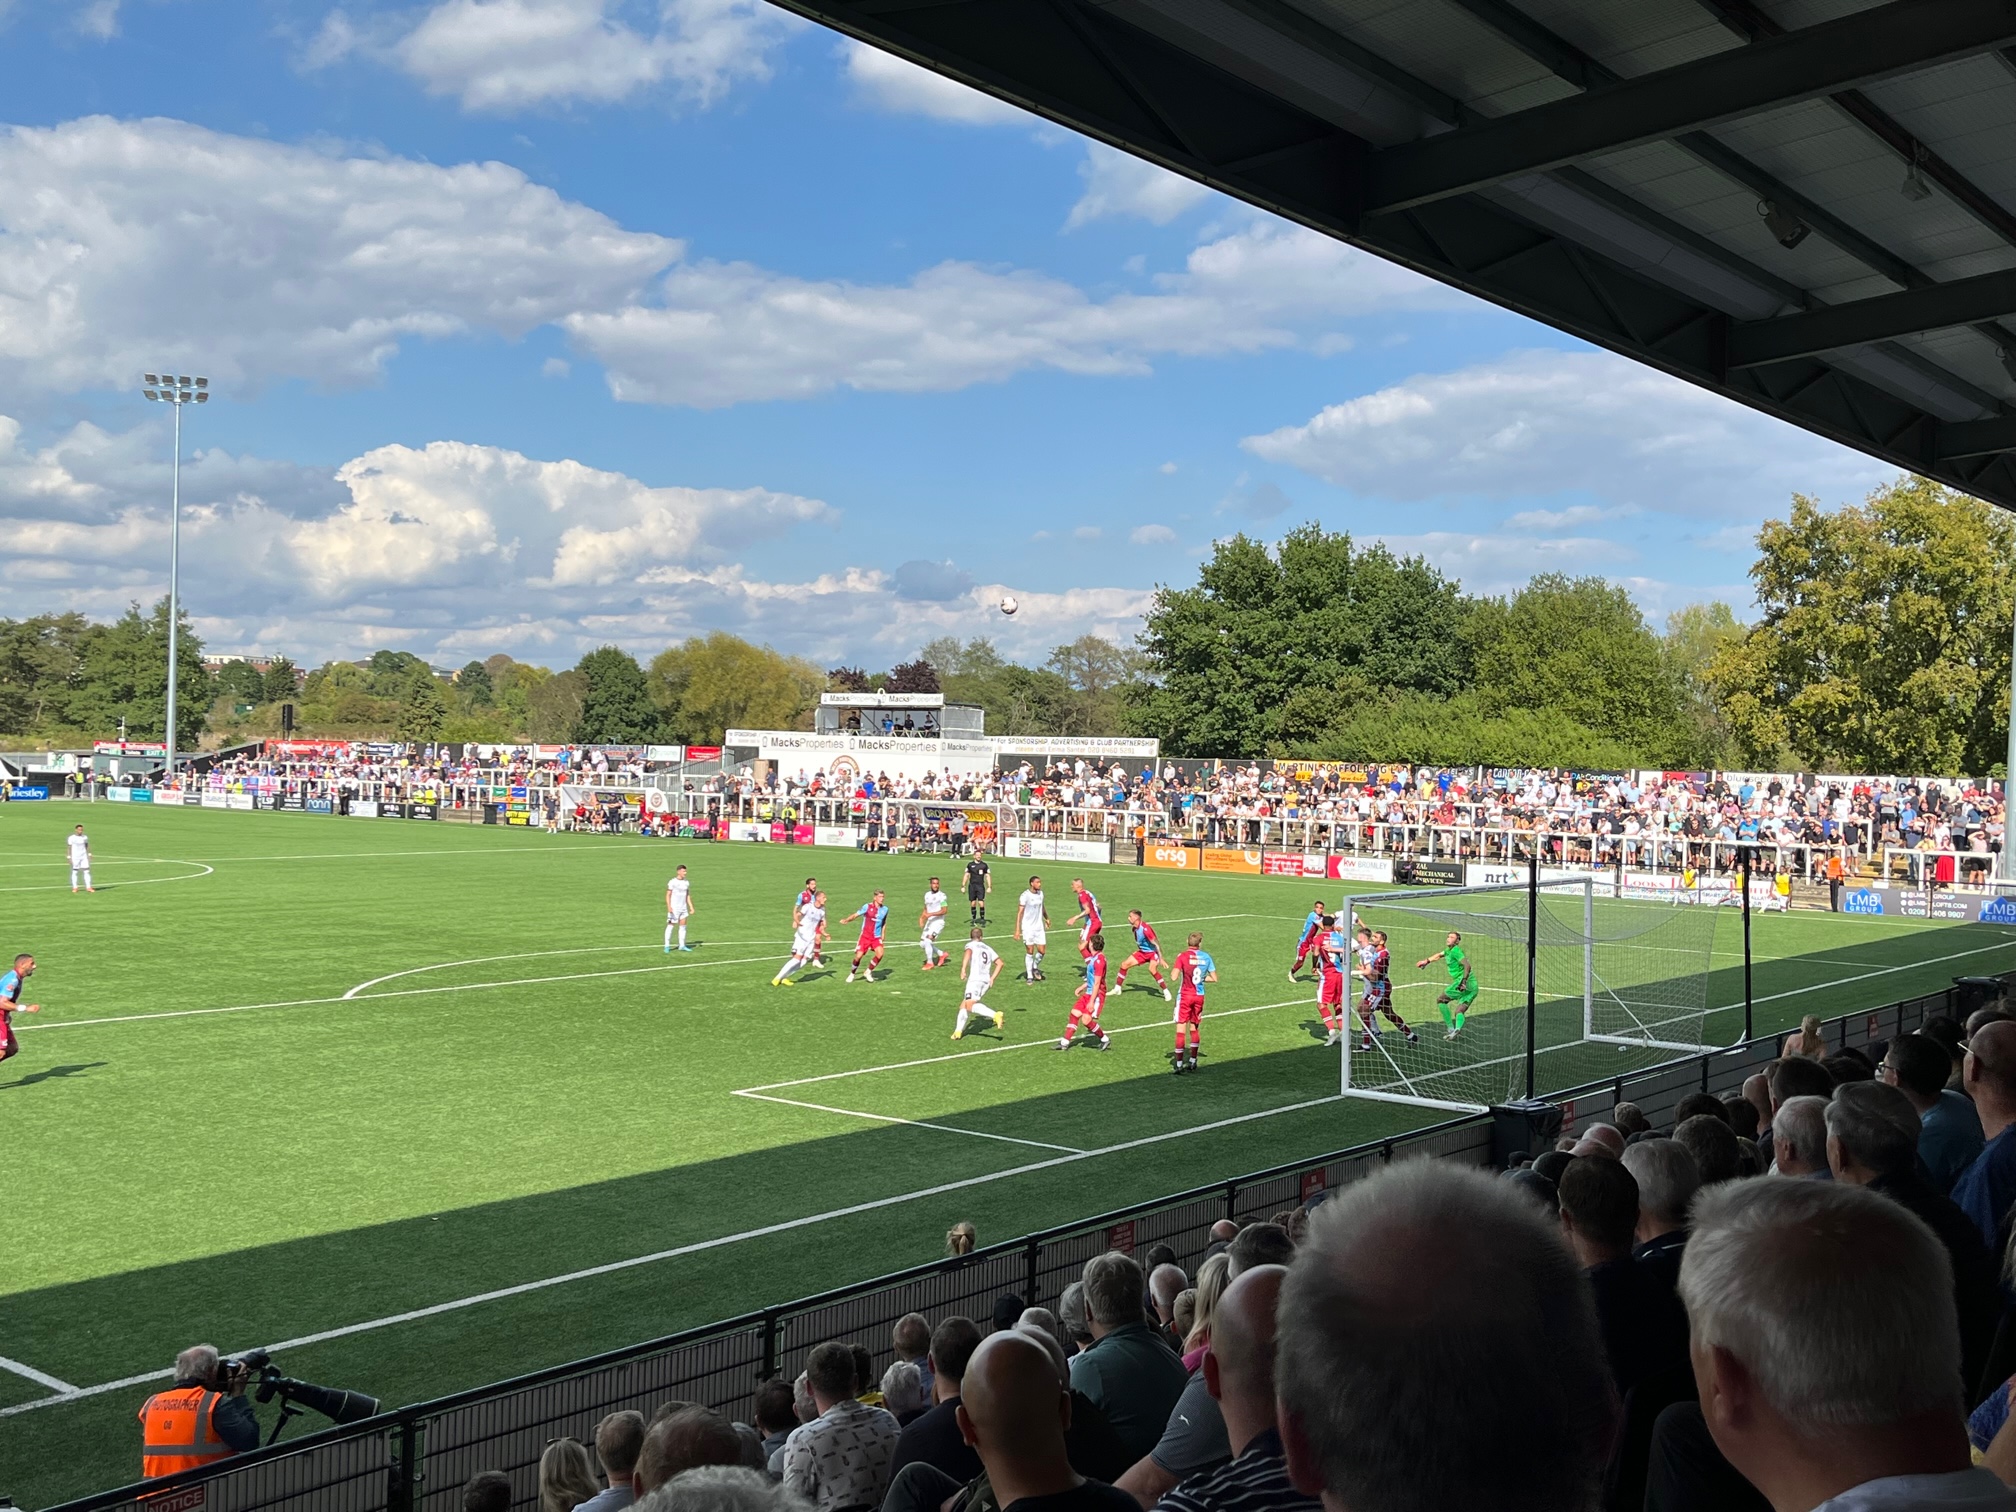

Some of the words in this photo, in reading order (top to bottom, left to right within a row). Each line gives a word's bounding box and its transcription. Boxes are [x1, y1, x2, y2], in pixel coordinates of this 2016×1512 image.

[771, 737, 844, 749] MacksProperties
[859, 739, 936, 752] MacksProperties
[948, 743, 992, 752] MacksProperties
[1279, 763, 1313, 771] MRTIN
[1321, 764, 1386, 774] SCAFFOLDG
[1726, 774, 1790, 785] bluesecuty
[925, 809, 959, 820] BROMLE
[966, 811, 994, 820] SIGNS
[1156, 848, 1186, 867] ersg
[1344, 858, 1356, 867] kw
[1358, 861, 1387, 869] BROMLEY
[1416, 870, 1455, 878] MECHANICAL
[1484, 873, 1508, 883] nrt
[1850, 895, 1878, 906] LMB
[1985, 904, 2016, 915] LMB
[982, 952, 988, 964] 9
[1192, 968, 1201, 984] 8
[148, 1490, 202, 1512] NOTICE
